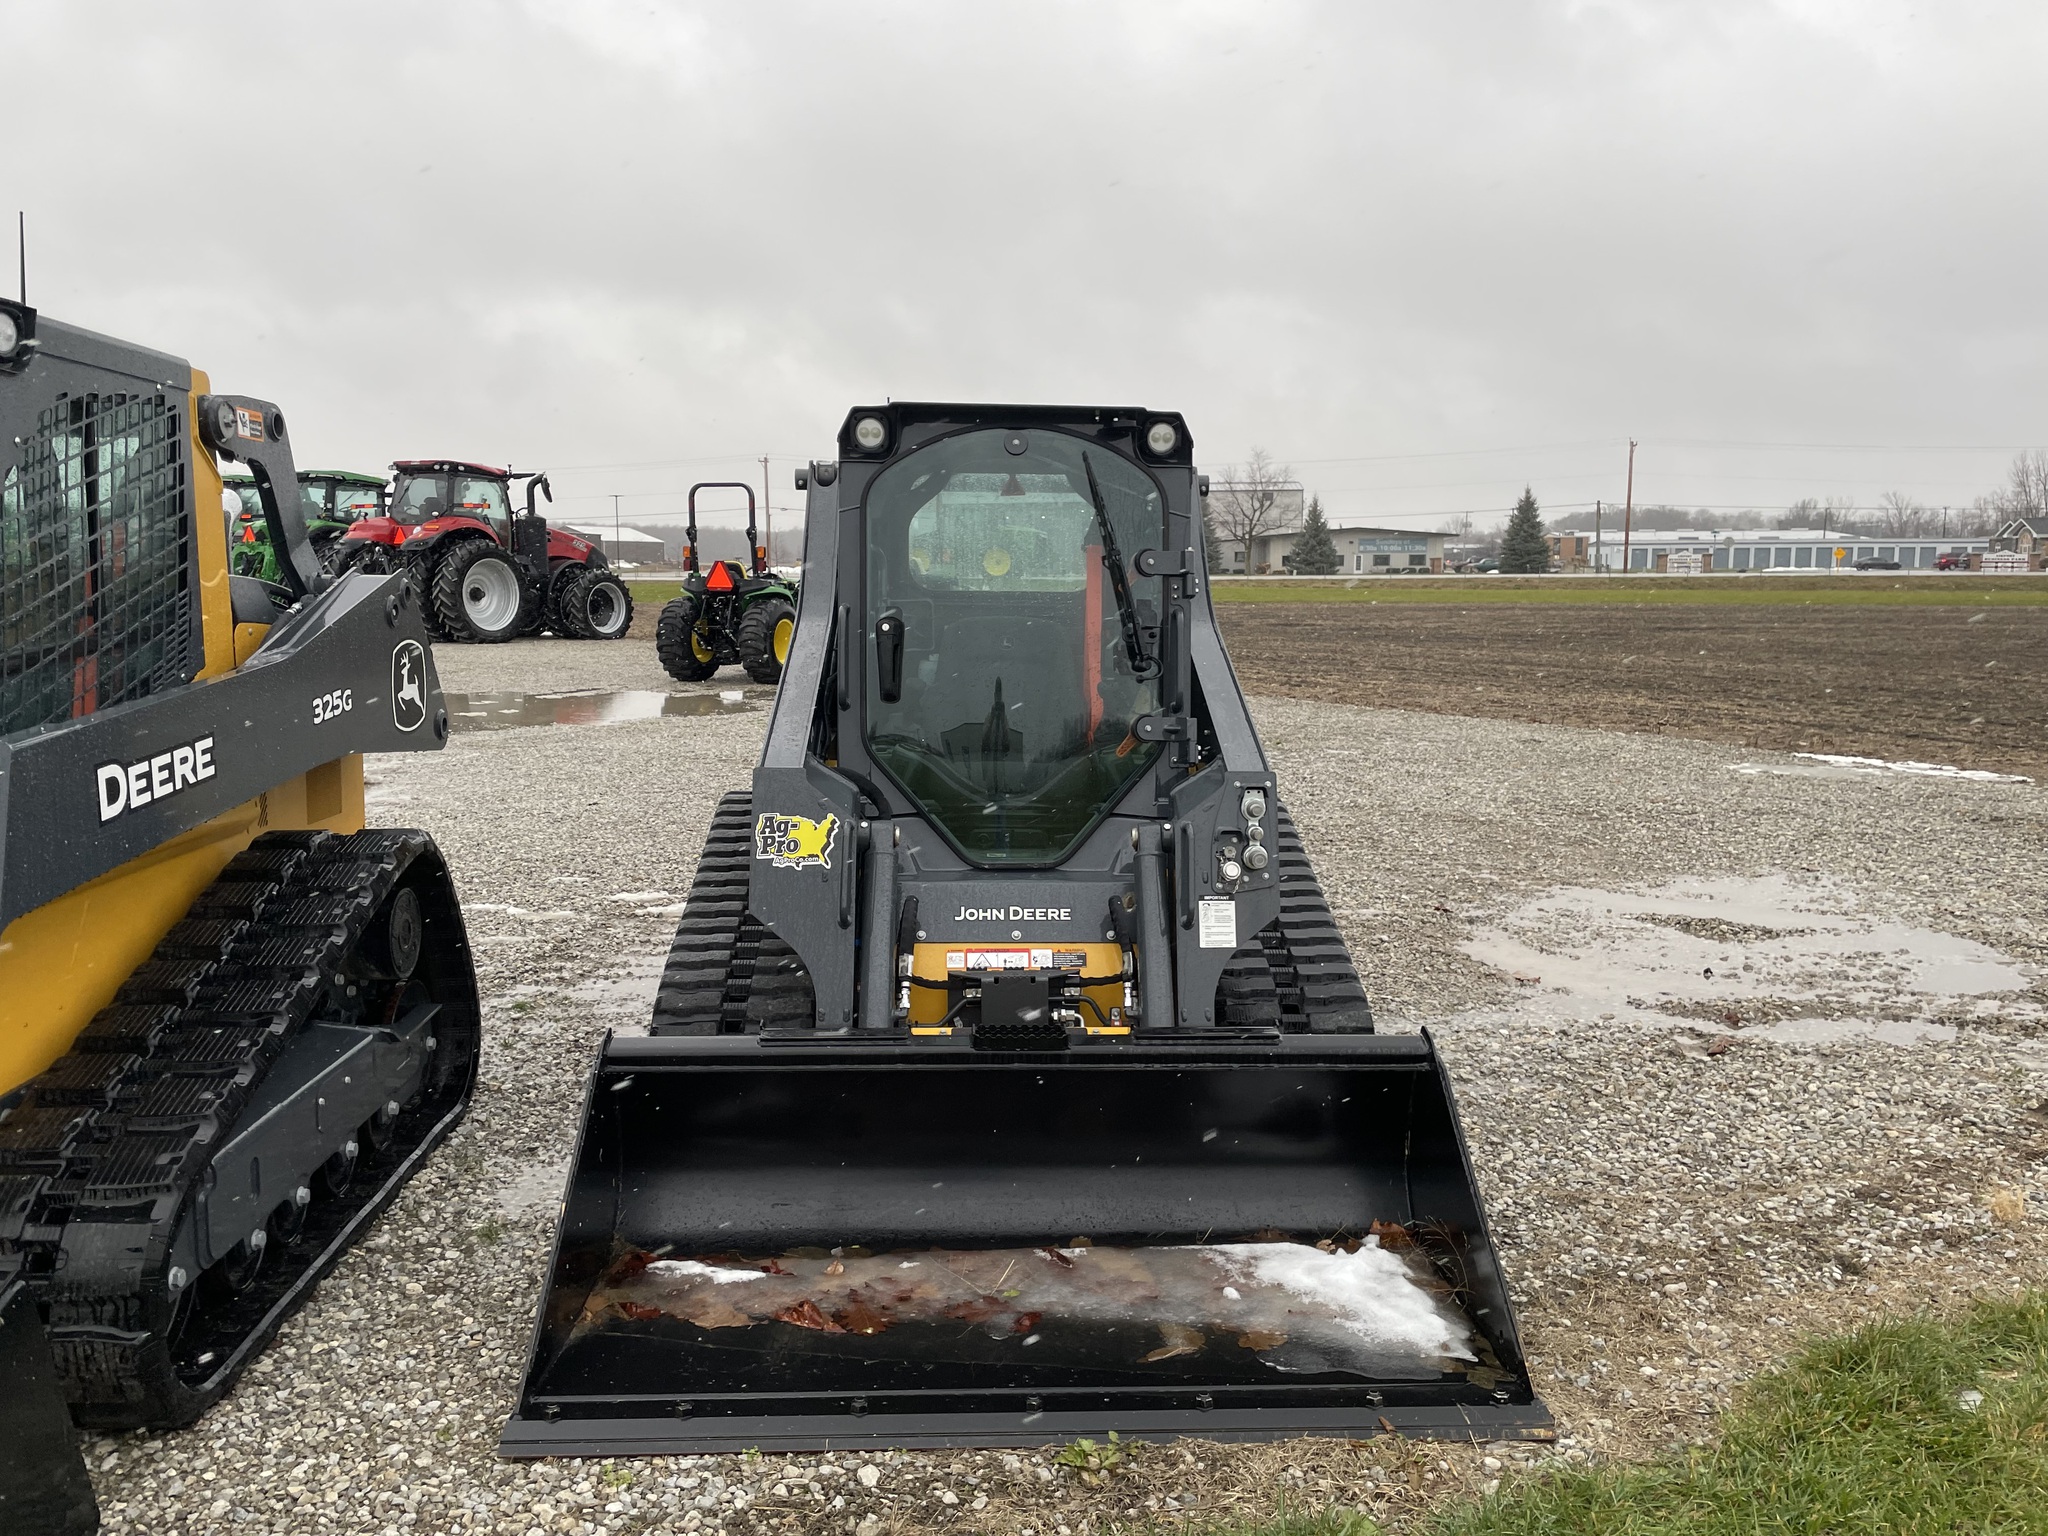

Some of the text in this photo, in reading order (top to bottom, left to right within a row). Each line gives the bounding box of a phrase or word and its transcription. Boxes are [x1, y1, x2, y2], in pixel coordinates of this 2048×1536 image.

[312, 688, 353, 725] 325G
[97, 736, 216, 822] DEERE
[760, 835, 800, 855] Pro
[954, 906, 1072, 921] JOHN DEERE
